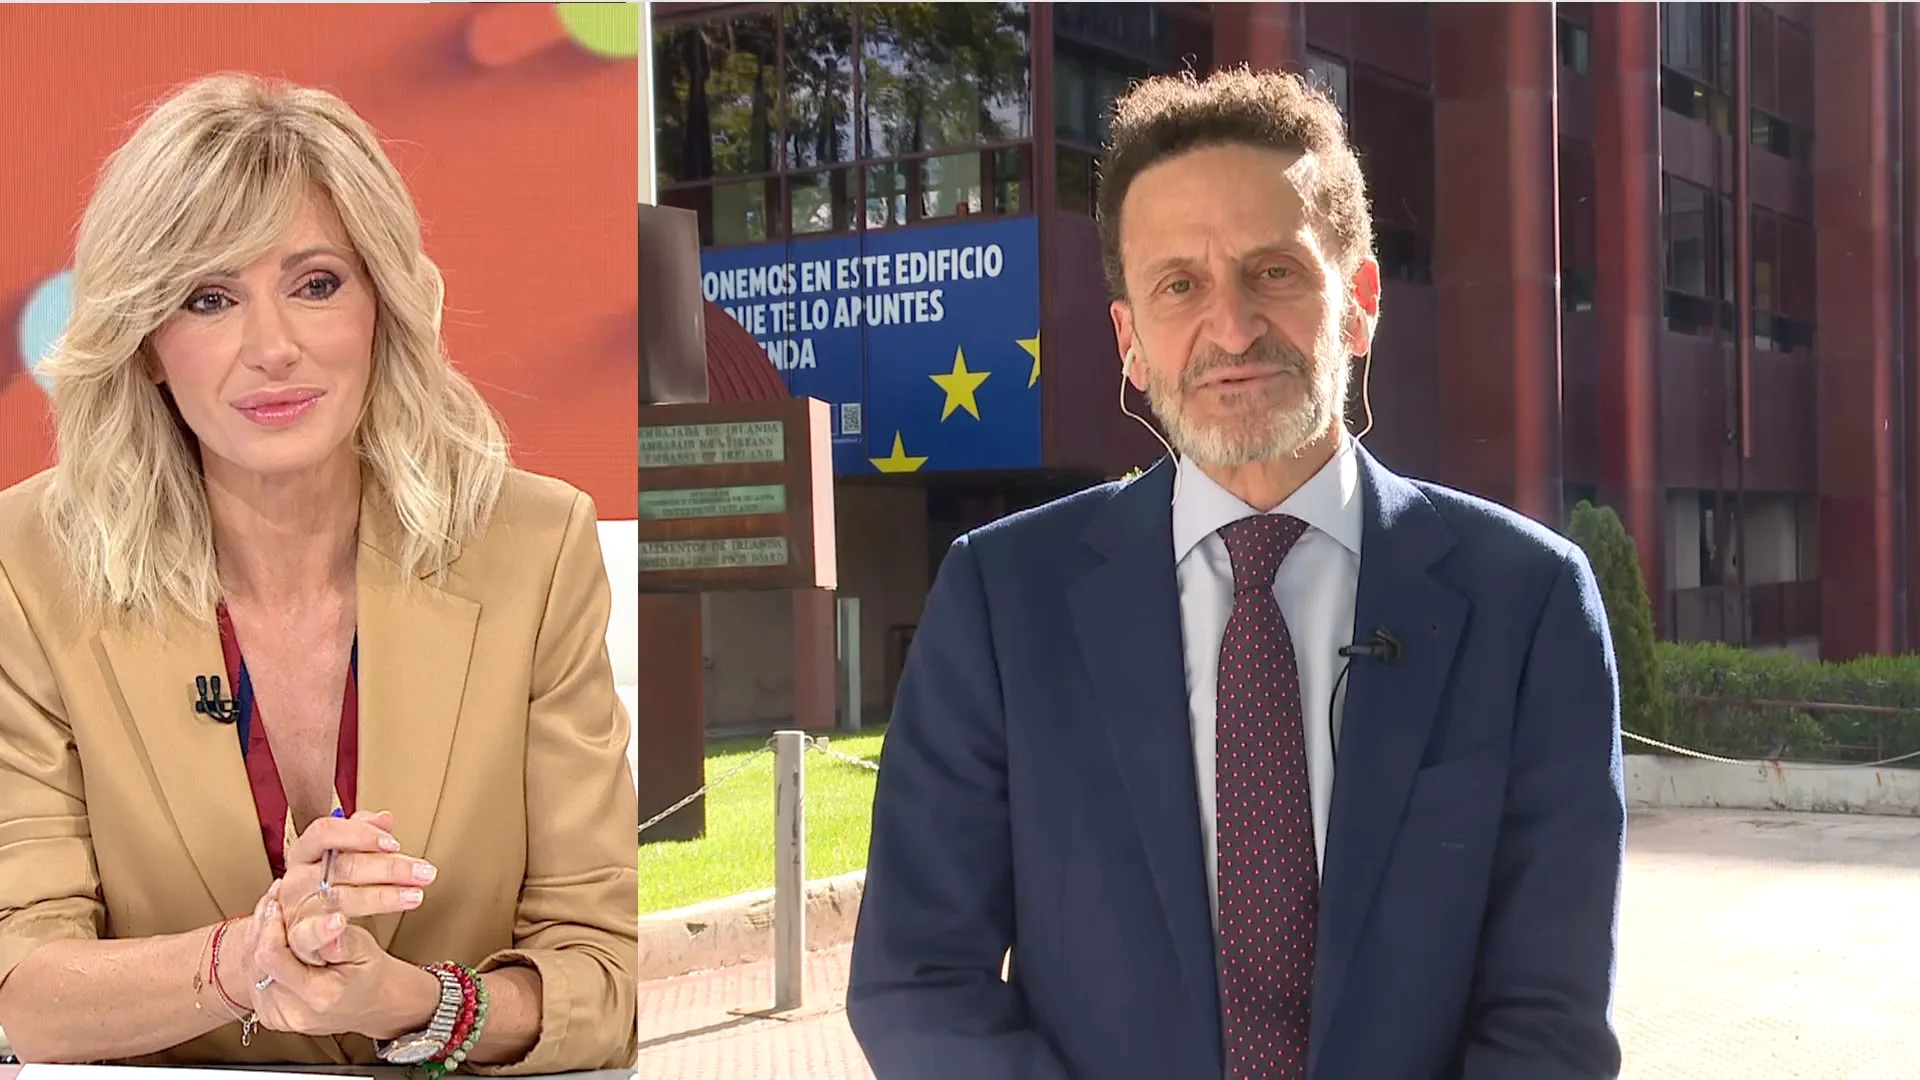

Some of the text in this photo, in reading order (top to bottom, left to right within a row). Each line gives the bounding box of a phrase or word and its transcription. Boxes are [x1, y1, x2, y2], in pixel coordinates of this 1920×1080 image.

[702, 244, 1003, 302] ONEMOS EN ESTE EDIFICIO
[724, 289, 944, 335] UE TE LO APUNTES
[757, 338, 817, 371] NDA
